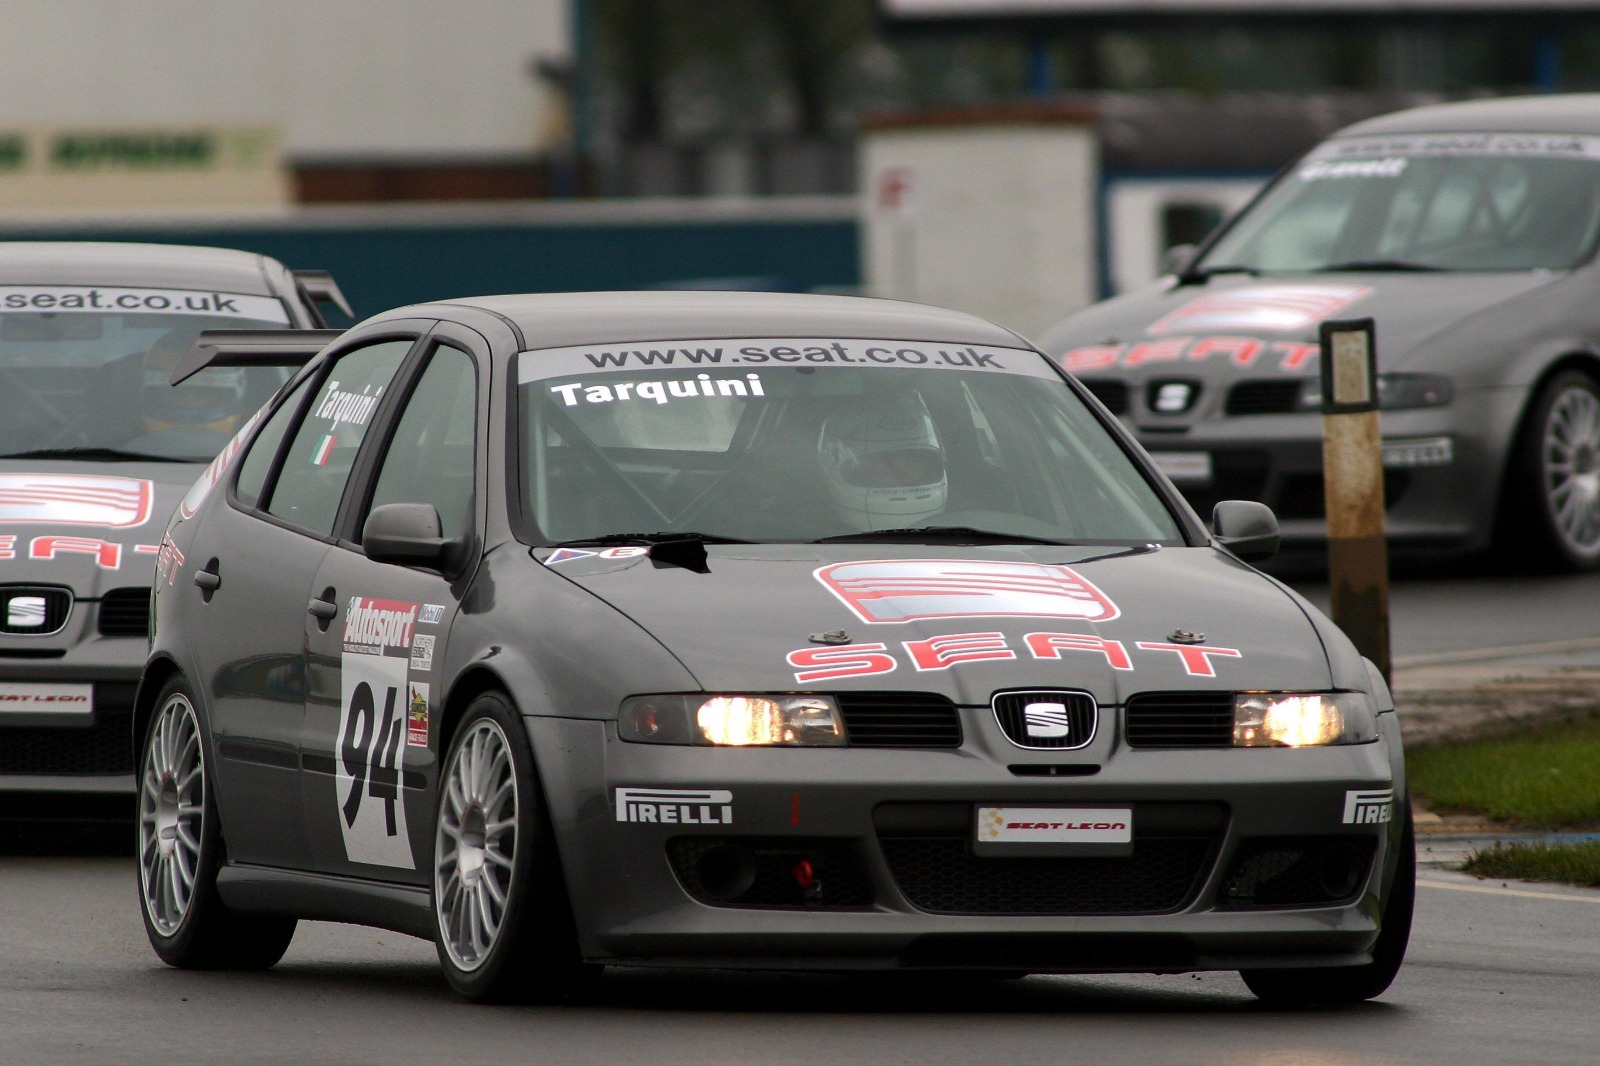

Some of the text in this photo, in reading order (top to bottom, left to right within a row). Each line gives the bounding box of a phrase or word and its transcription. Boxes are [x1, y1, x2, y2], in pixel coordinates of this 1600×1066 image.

[584, 342, 1006, 370] www.seat.co.uk
[315, 381, 383, 432] Tarquini
[551, 373, 765, 406] Tarquini
[343, 597, 416, 656] Autosport
[785, 632, 1243, 683] SEAT
[341, 681, 402, 836] 94
[616, 788, 733, 824] PIRELLI
[1006, 822, 1063, 830] SEAT
